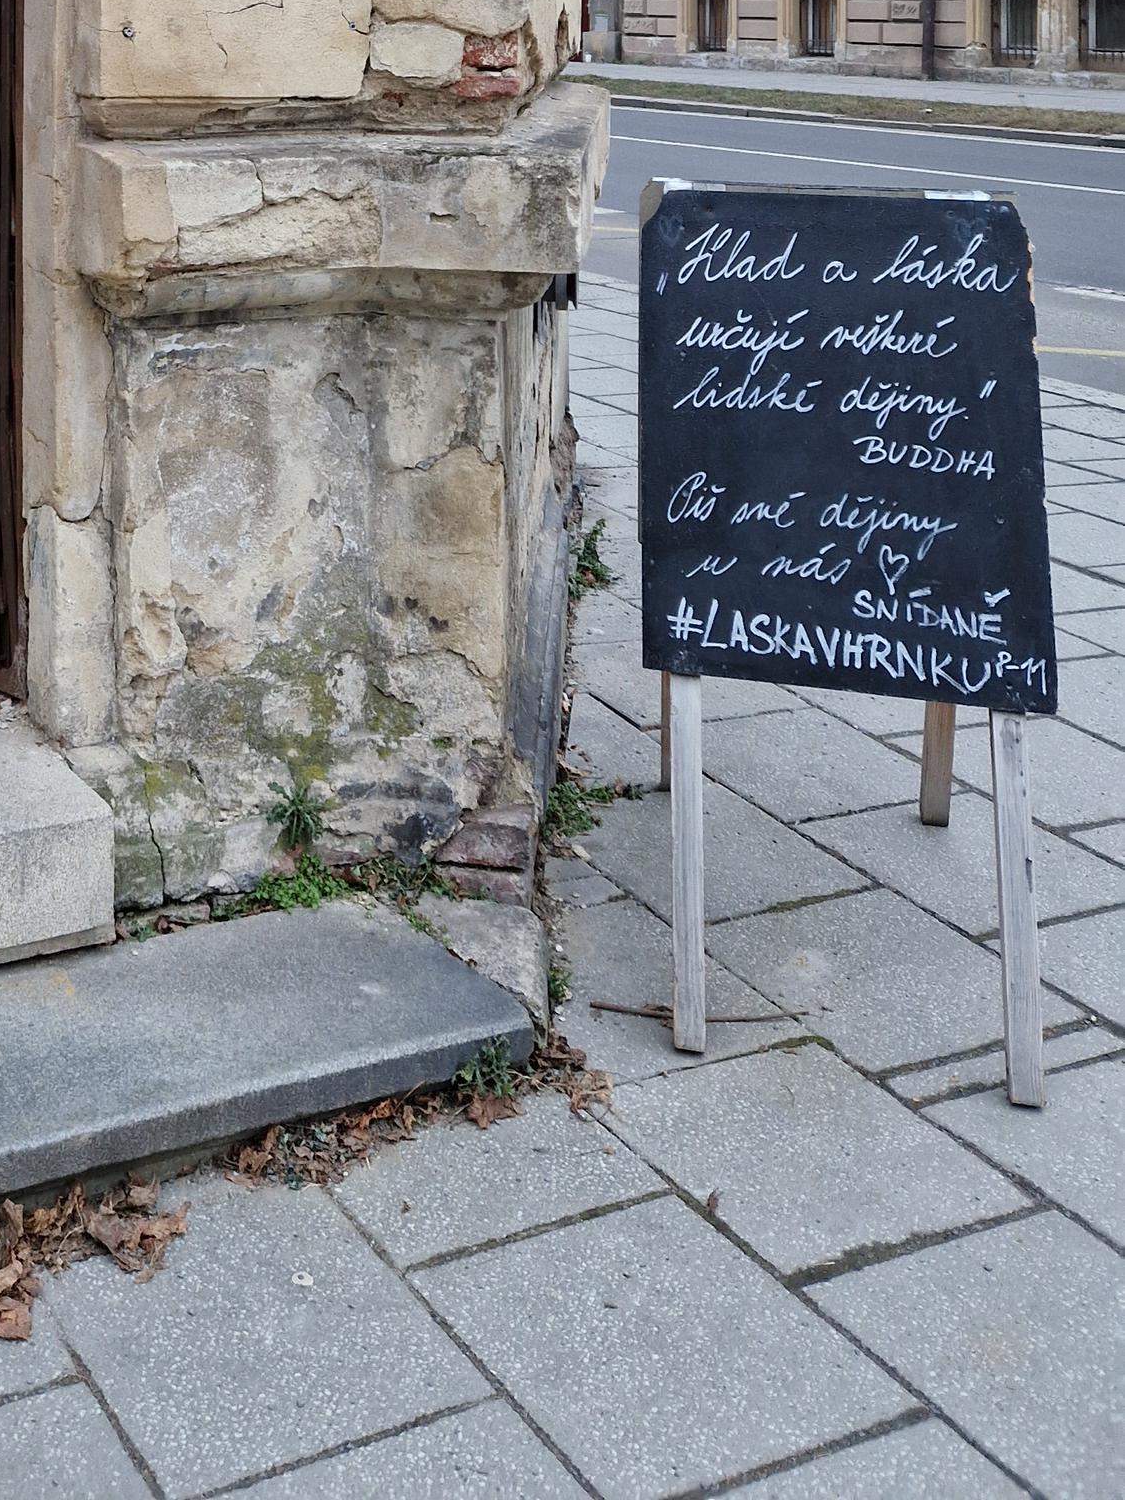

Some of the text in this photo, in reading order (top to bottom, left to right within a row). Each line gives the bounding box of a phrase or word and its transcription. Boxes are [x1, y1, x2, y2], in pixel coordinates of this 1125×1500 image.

[822, 260, 858, 283] a
[873, 233, 1021, 293] láska
[676, 309, 958, 376] určují veškeré
[673, 366, 823, 413] lidské
[852, 436, 996, 481] BUDDHA
[667, 471, 959, 561] Piš své dějiny
[686, 543, 853, 584] u nás
[667, 596, 992, 696] #LASKAVHRNKU
[852, 586, 1011, 646] SNÍDANĚ
